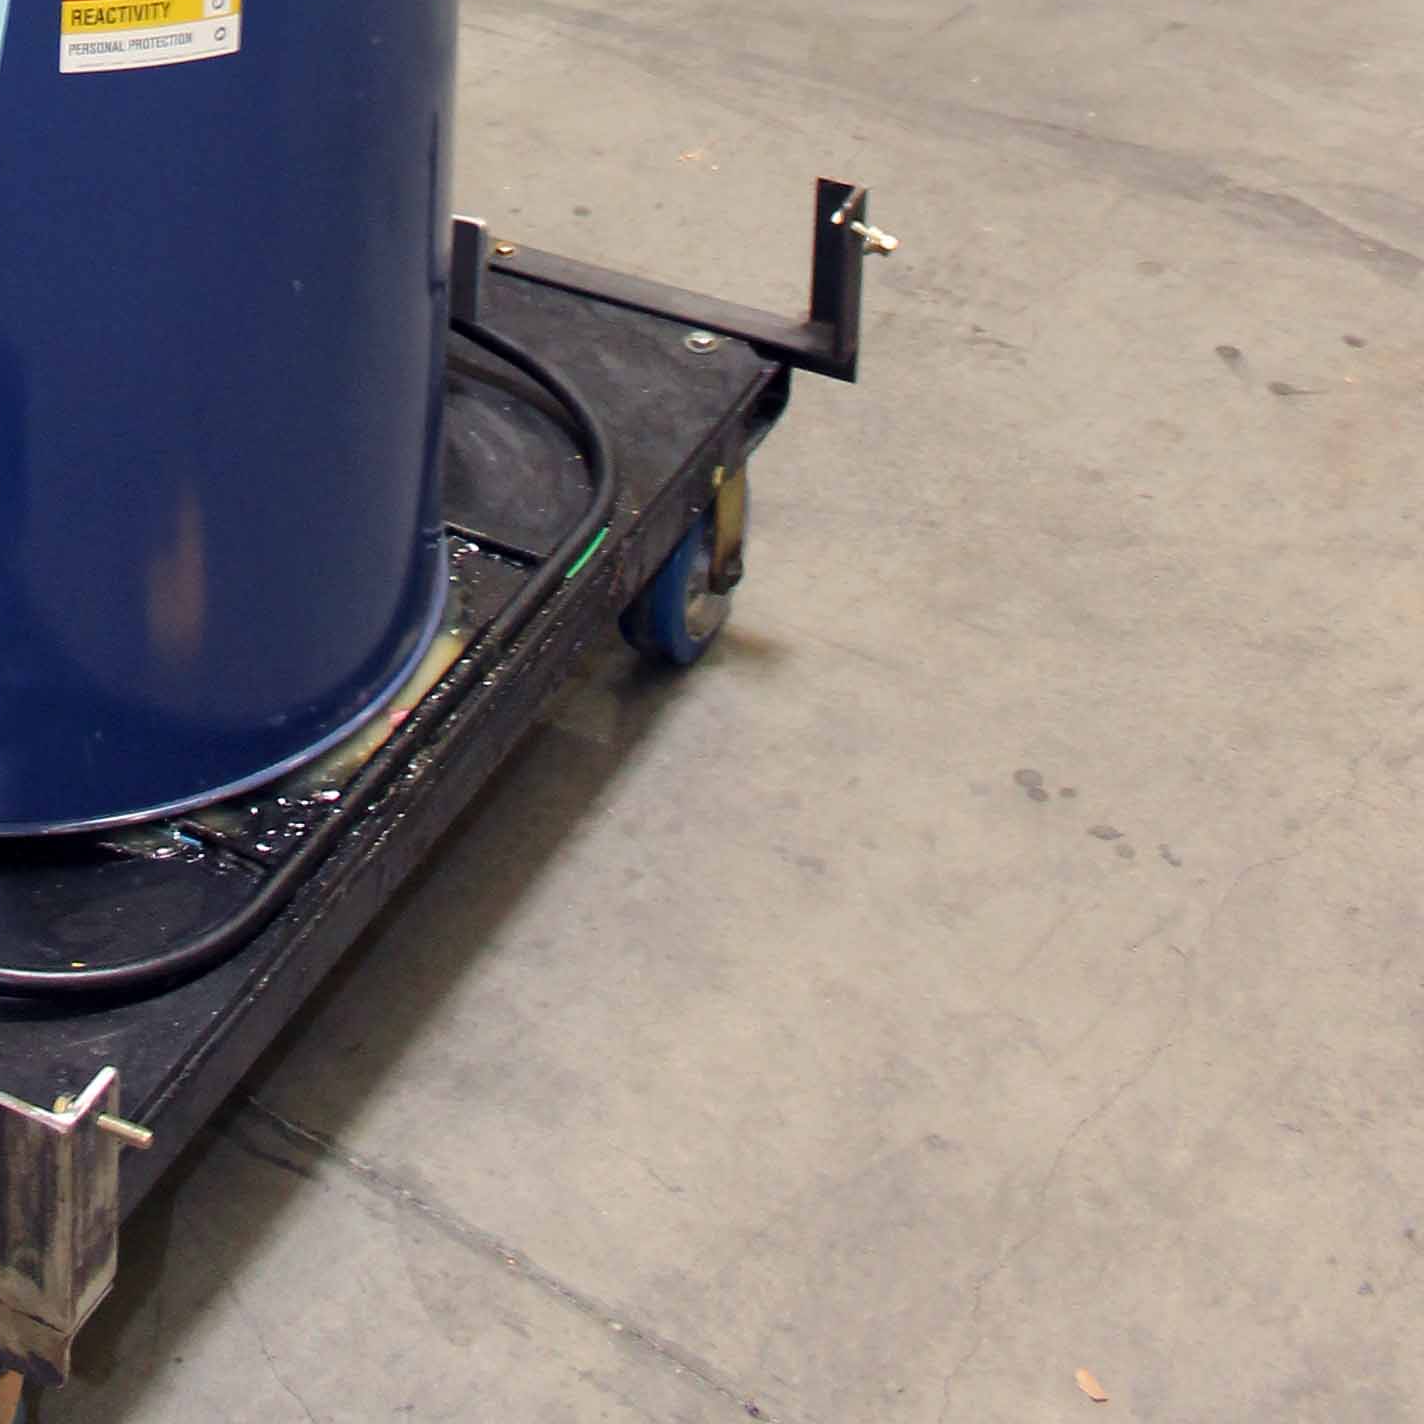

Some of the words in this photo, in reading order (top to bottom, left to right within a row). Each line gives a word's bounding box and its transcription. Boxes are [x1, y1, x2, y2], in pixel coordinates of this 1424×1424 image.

[71, 2, 172, 26] REACTIVITY
[67, 39, 125, 57] PERSONAL
[127, 32, 193, 51] PROTECTION
